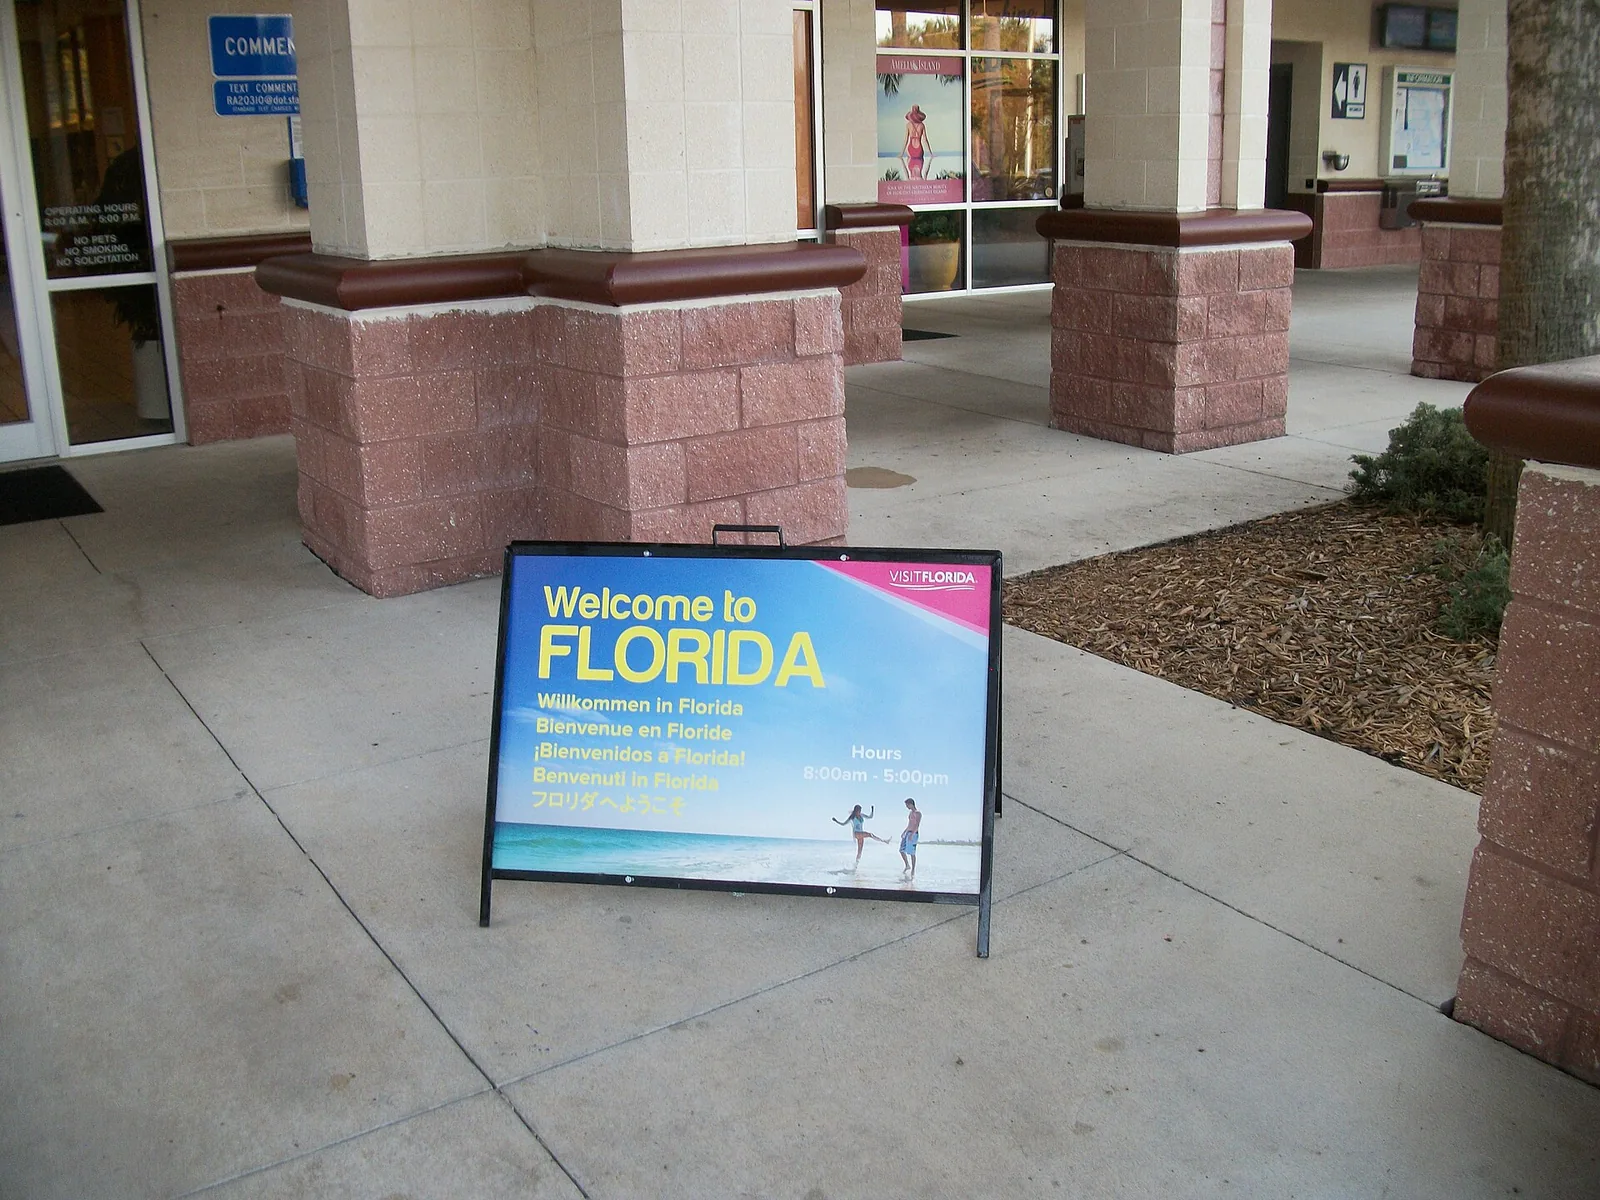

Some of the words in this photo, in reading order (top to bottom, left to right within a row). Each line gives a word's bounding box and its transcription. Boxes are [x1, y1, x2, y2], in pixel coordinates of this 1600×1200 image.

[918, 60, 941, 70] ISLAND
[229, 83, 248, 93] TEXT
[44, 205, 101, 216] OPERATING
[103, 202, 139, 213] HOURS
[98, 214, 119, 224] 5:00
[73, 236, 88, 245] NO
[91, 234, 117, 244] PETS
[64, 247, 80, 256] NO
[83, 243, 128, 254] SMOKING
[56, 258, 72, 267] NO
[74, 252, 139, 266] SOLICITATION
[543, 585, 714, 621] Welcome
[723, 589, 757, 623] to
[538, 624, 826, 688] FLORIDA
[537, 693, 650, 713] Willkommen
[656, 696, 673, 713] in
[678, 697, 744, 716] Florida
[536, 717, 633, 737] Bienvenue
[638, 724, 661, 738] en
[667, 722, 733, 741] Floride
[534, 742, 652, 763] ¡Bienvenidos
[658, 752, 669, 764] a
[674, 747, 746, 766] Florida!
[851, 744, 902, 760] Hours
[533, 767, 626, 786] Benvenuti
[631, 771, 648, 788] in
[654, 772, 719, 791] Florida
[803, 765, 868, 782] 8:00am
[883, 768, 949, 787] 5:00pm
[531, 790, 687, 817] フロリダへようこそ
